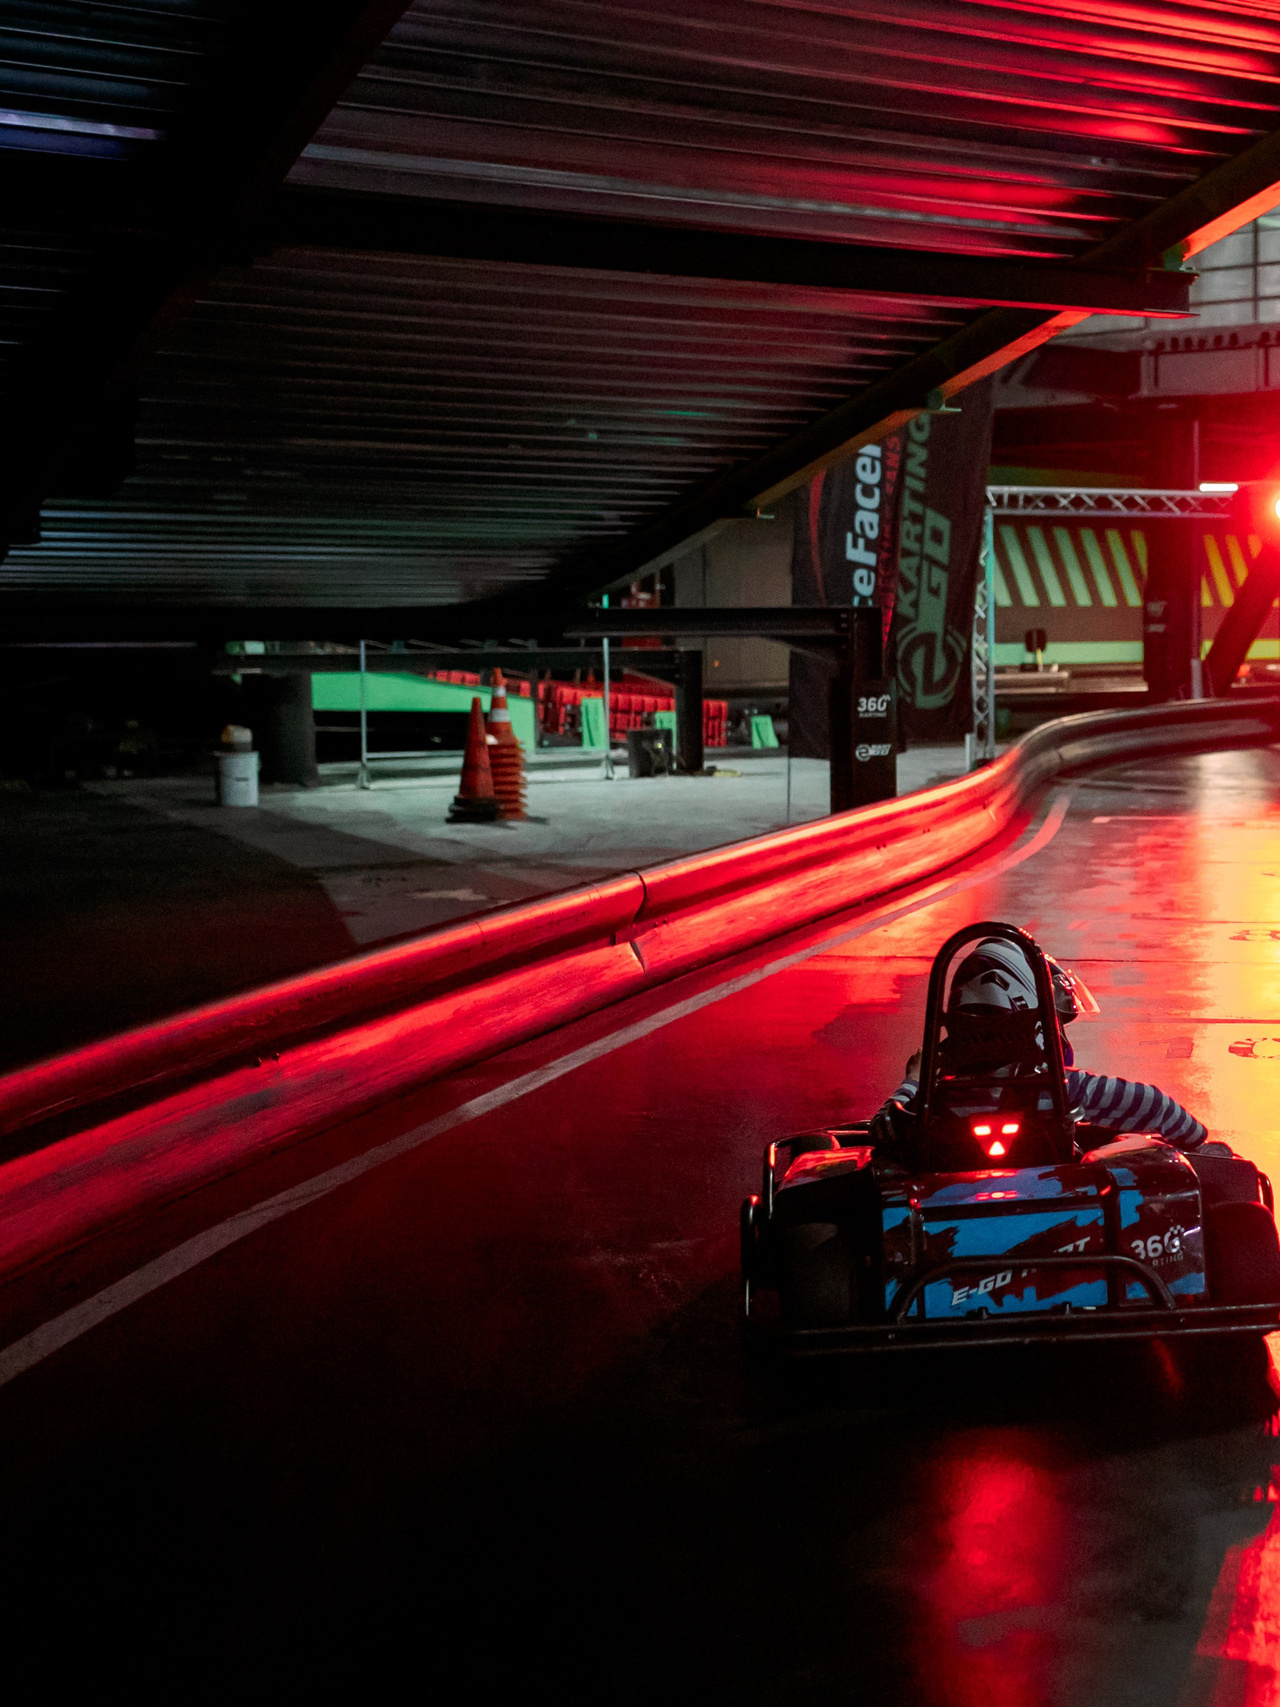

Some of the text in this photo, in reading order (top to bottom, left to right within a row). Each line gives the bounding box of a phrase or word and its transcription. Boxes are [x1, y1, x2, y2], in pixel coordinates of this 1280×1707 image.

[845, 443, 882, 608] eFace
[897, 412, 931, 622] KARTING
[857, 694, 890, 712] 360
[952, 1269, 1012, 1306] E-GO
